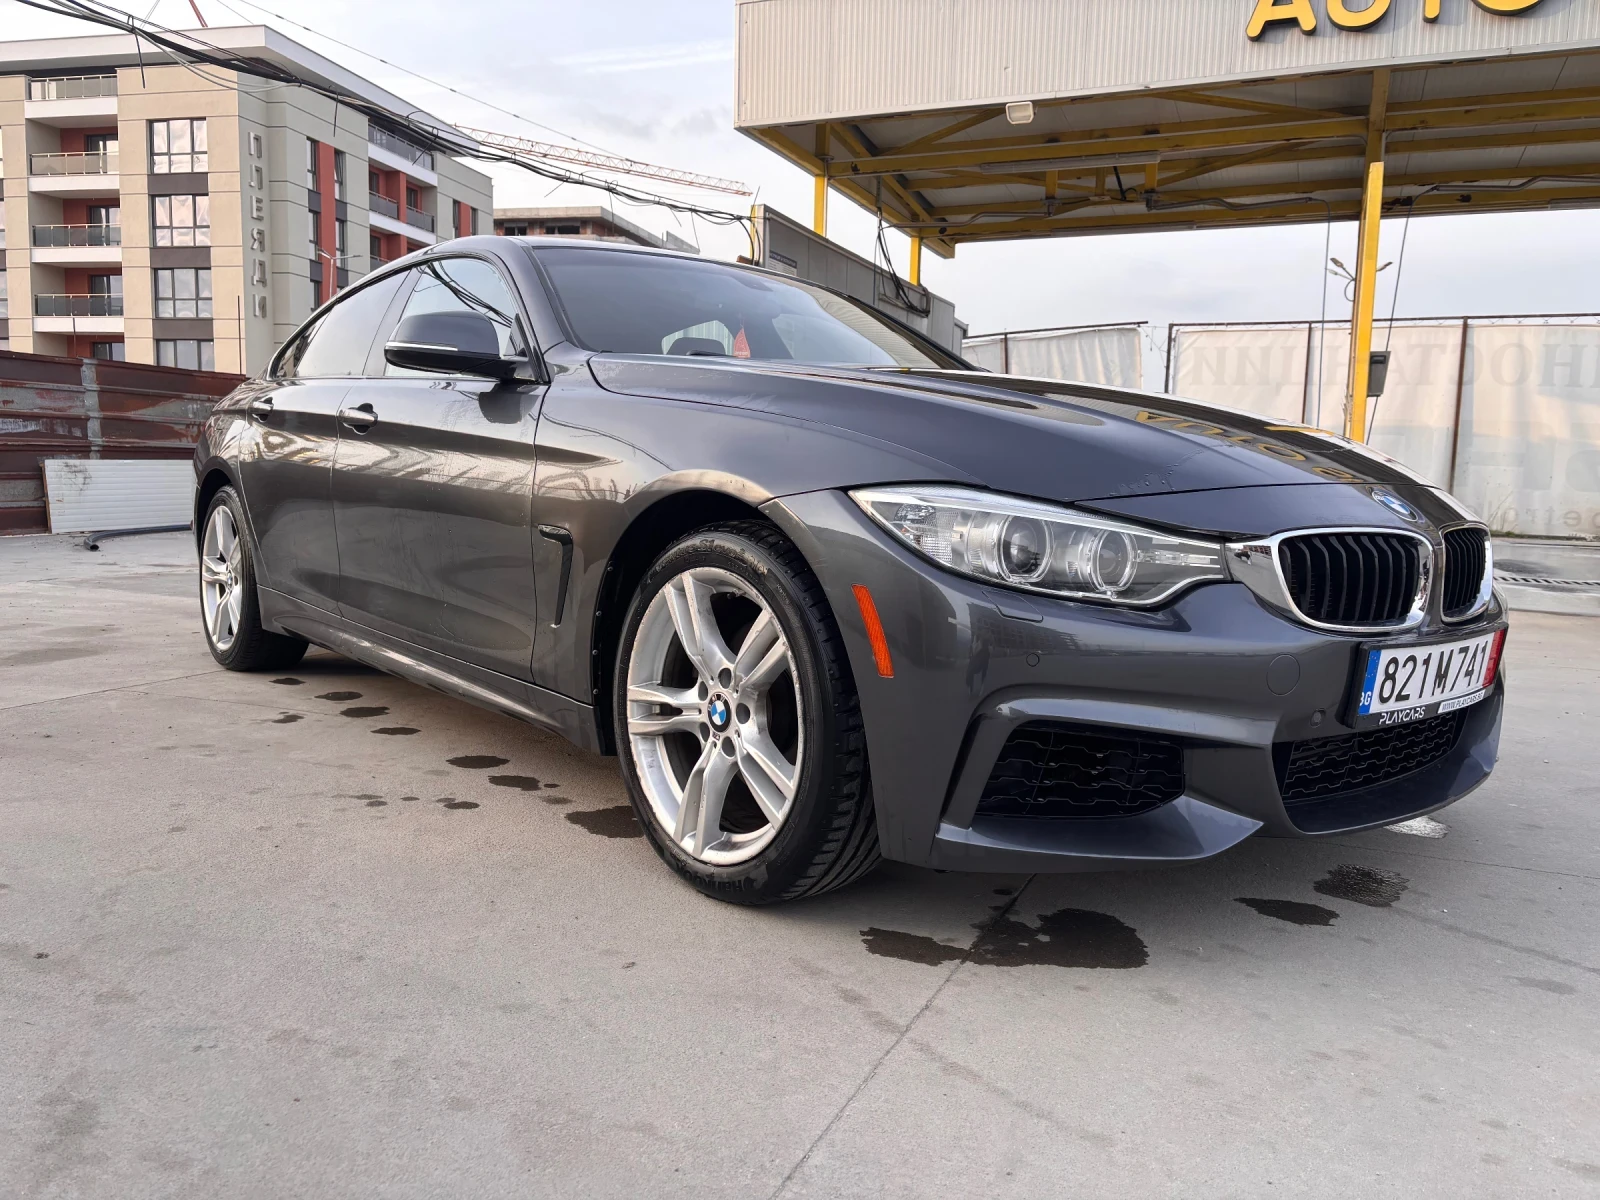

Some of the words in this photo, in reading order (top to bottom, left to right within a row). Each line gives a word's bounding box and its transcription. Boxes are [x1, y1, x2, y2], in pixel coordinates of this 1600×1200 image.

[248, 131, 268, 319] ПЛЕЯДИ
[1379, 641, 1488, 704] 821M741
[1379, 706, 1426, 726] PLAYCARS
